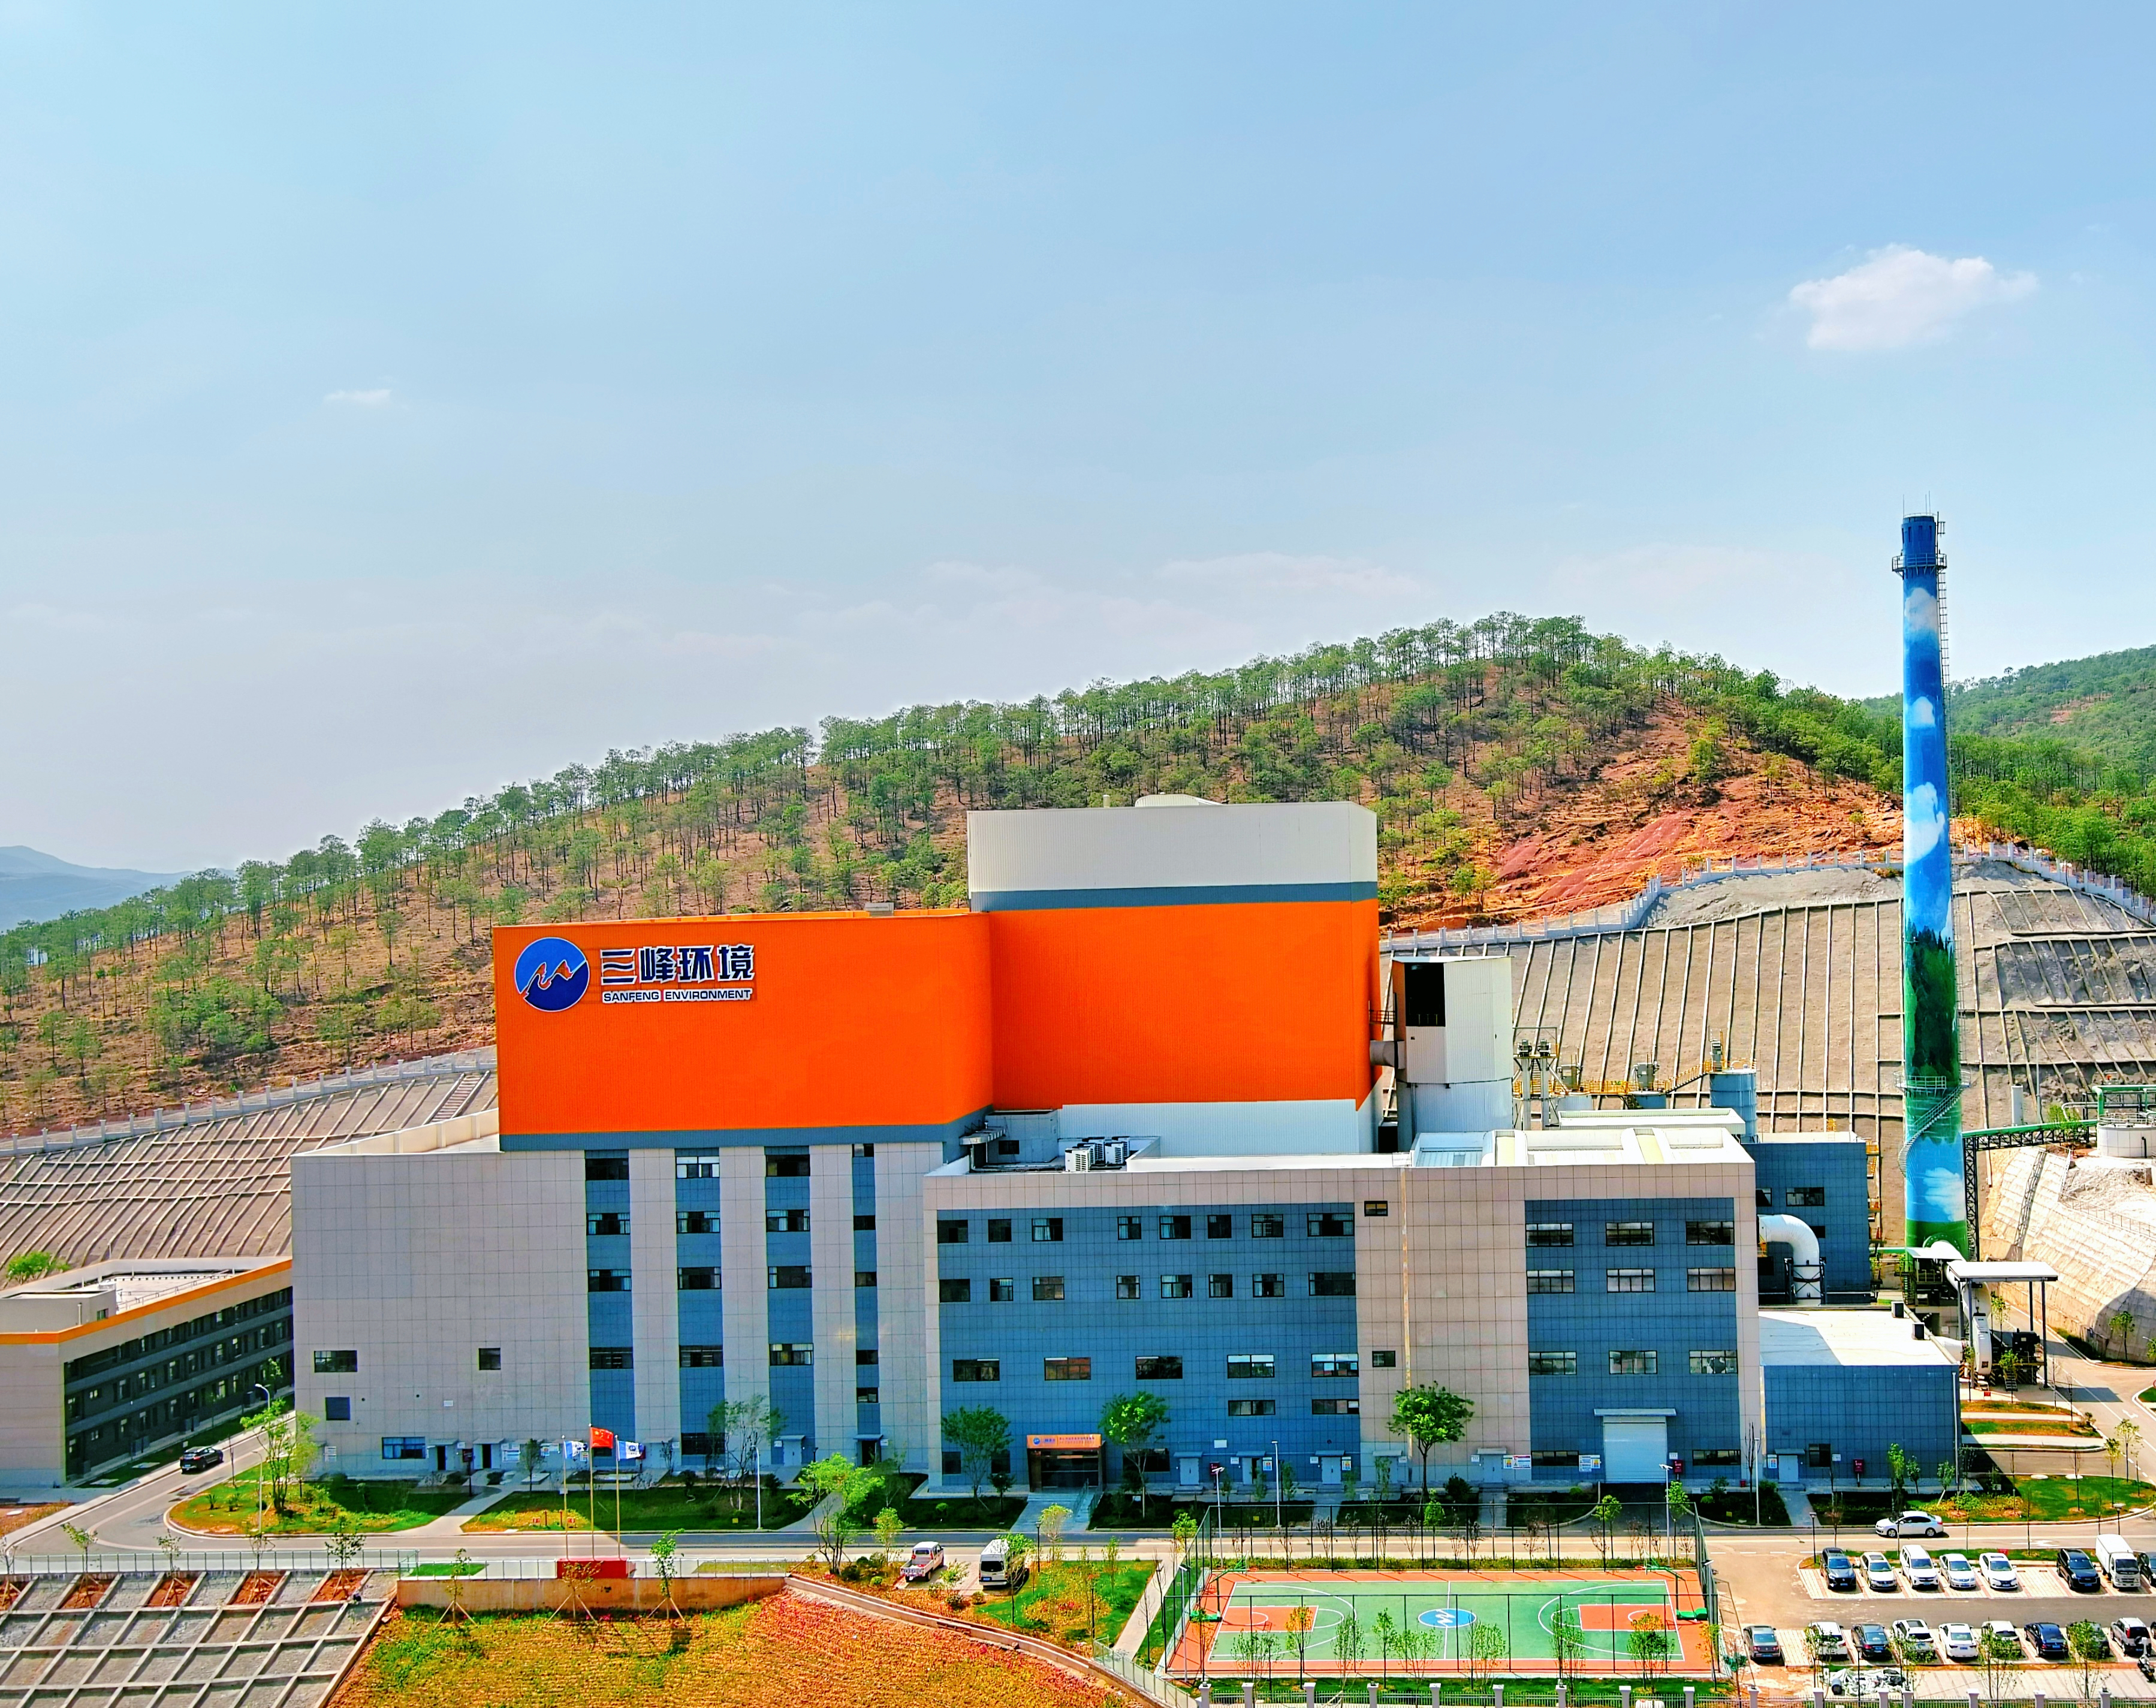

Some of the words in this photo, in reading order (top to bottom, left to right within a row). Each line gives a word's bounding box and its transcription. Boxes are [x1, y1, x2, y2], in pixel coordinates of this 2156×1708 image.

[601, 945, 754, 984] 三峰环境
[604, 991, 660, 1002] SANFENG
[665, 989, 751, 1000] ENVIRONMENT
